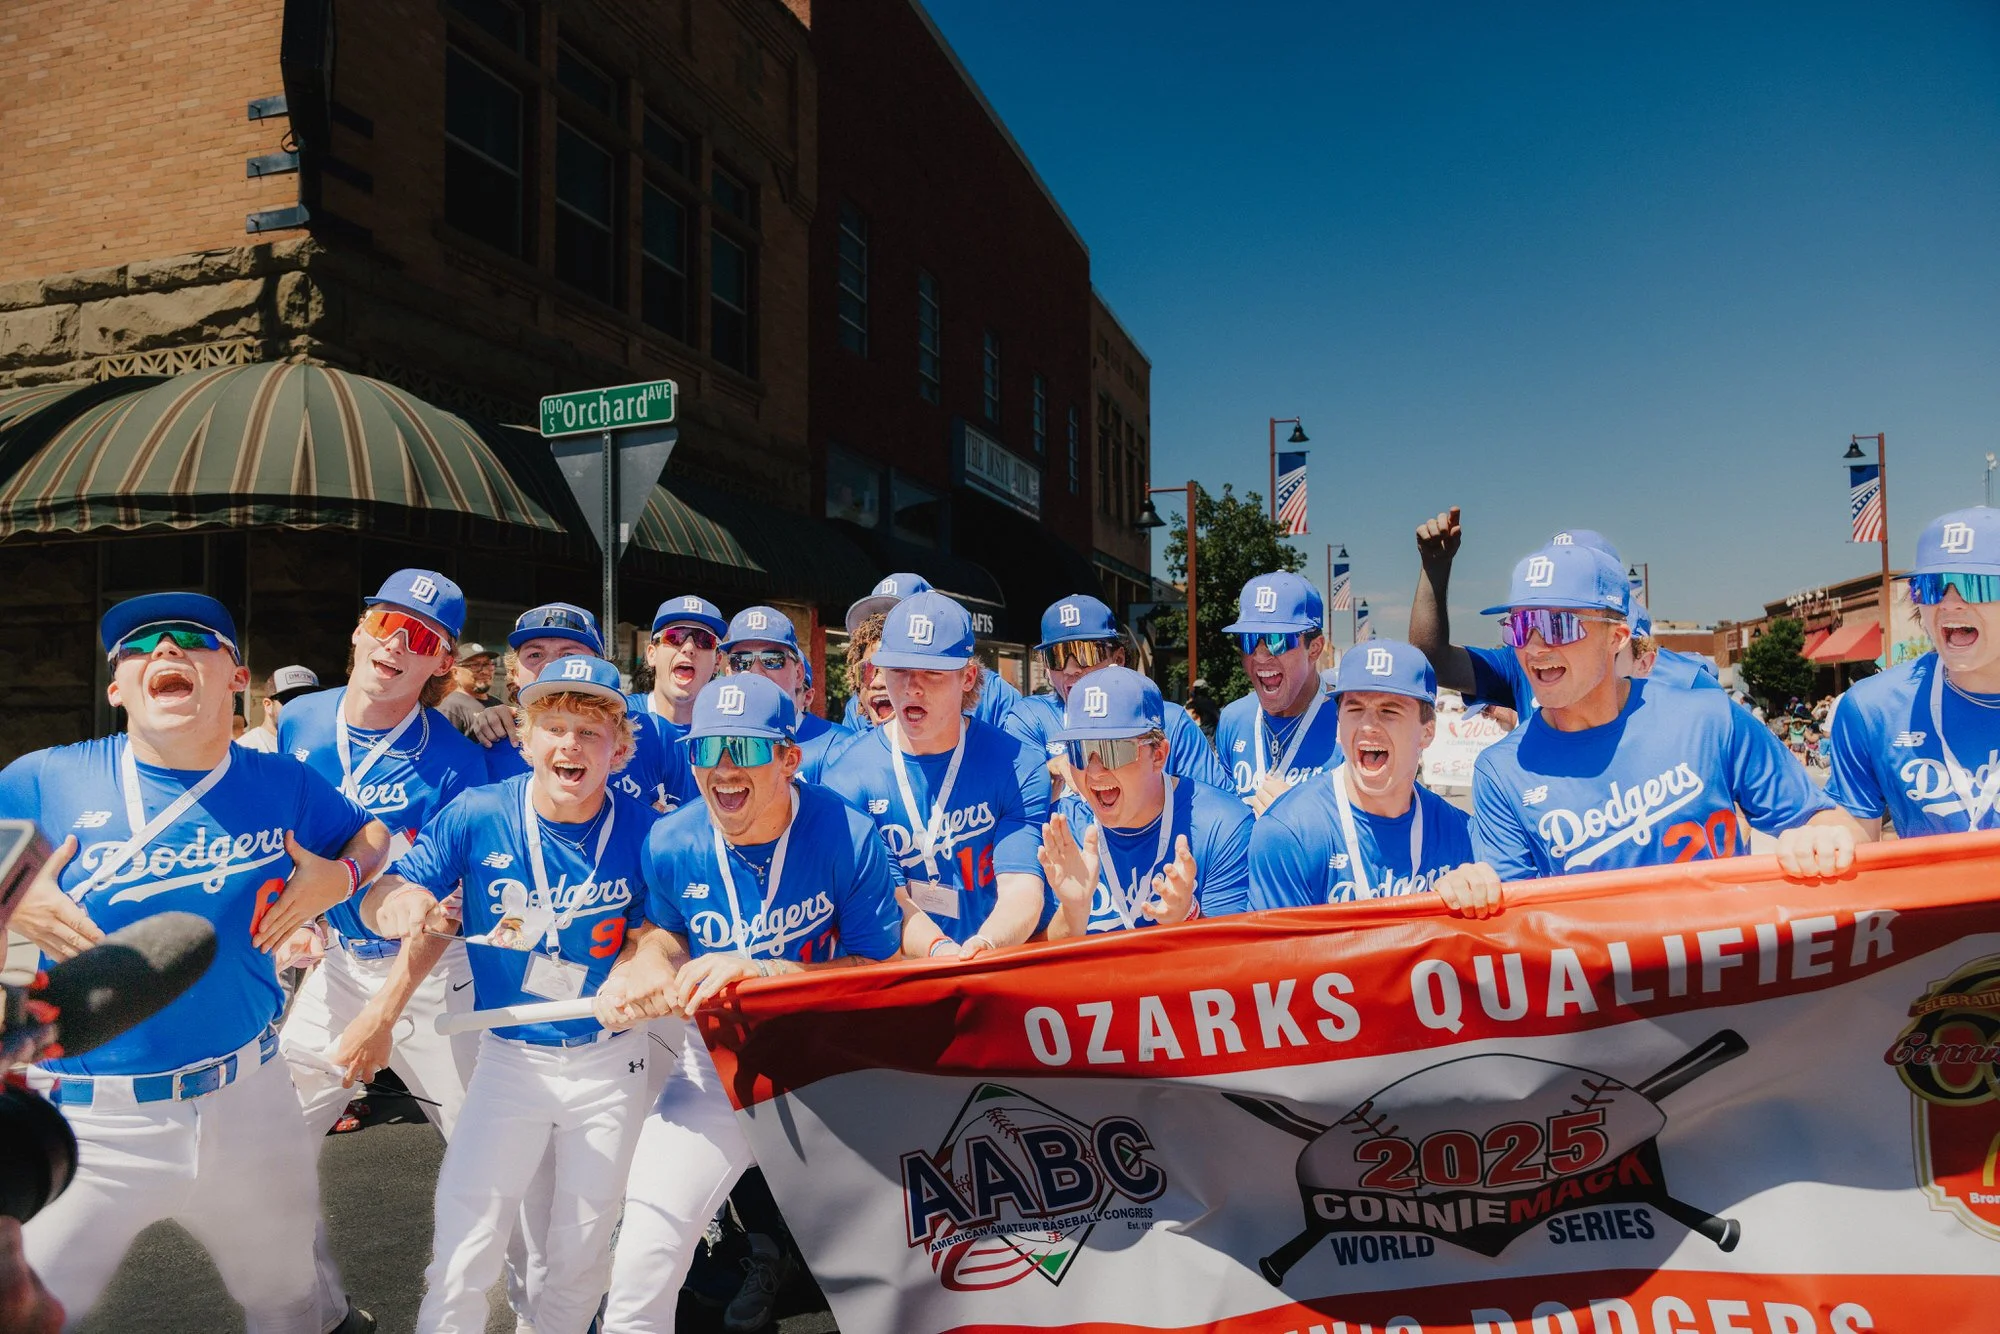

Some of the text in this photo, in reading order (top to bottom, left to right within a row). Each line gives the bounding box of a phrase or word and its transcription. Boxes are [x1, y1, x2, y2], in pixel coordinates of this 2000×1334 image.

[543, 398, 563, 415] 100
[549, 417, 556, 433] S
[563, 383, 670, 428] Orchard AVE
[971, 612, 994, 634] AFTS
[880, 801, 995, 860] Dgers
[1538, 763, 1703, 862] Dodgers
[1662, 808, 1737, 864] 20
[82, 827, 284, 895] Dodgers
[589, 917, 627, 959] 9
[690, 891, 834, 957] Dodgers
[1024, 909, 1900, 1067] OZARKS QUALIFIER
[1354, 1108, 1609, 1191] 2025
[901, 1116, 1168, 1249] AABC
[1312, 1150, 1654, 1233] CONNIE MACK
[930, 1208, 1153, 1252] AMERICAN AMATEUR BASEBALL CONGRESS
[1127, 1221, 1140, 1230] Est.
[1331, 1208, 1655, 1266] WORLD SERIES
